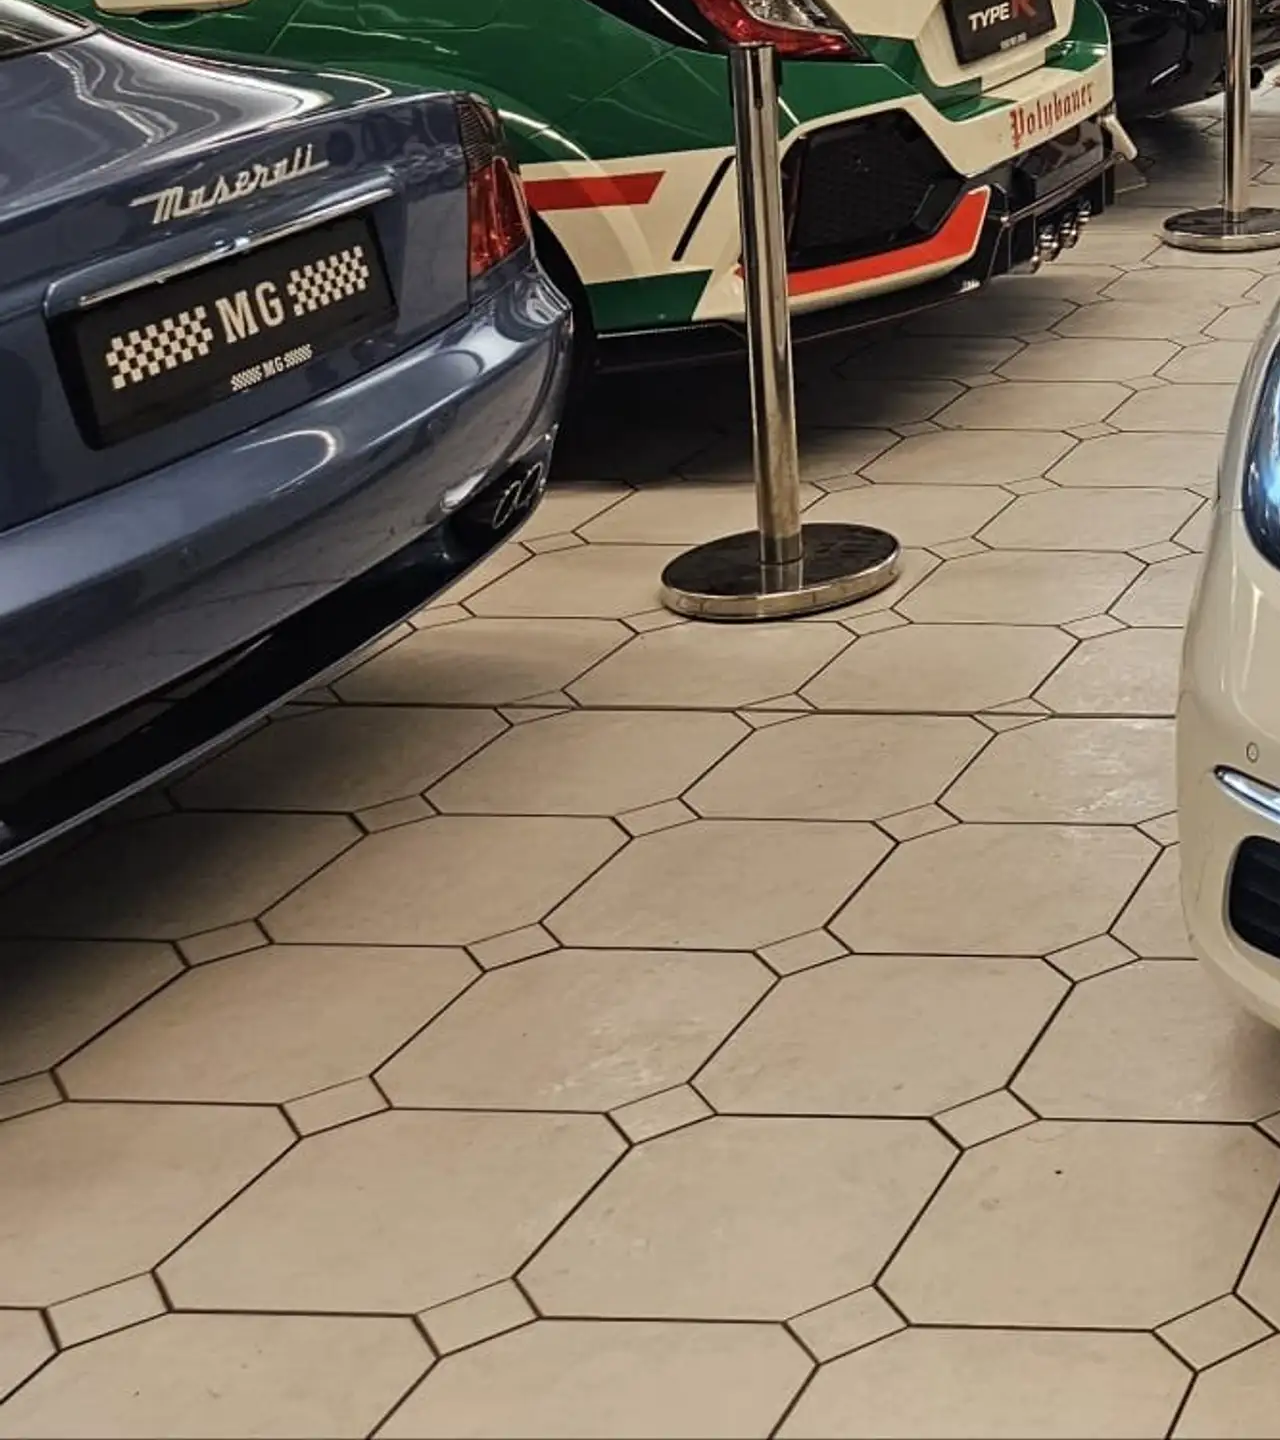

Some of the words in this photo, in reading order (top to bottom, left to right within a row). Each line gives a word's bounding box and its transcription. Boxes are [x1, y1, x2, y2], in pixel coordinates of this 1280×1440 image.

[968, 2, 1010, 31] TYPE
[130, 144, 329, 224] Maserati
[215, 280, 286, 344] MG
[262, 355, 286, 380] MG
